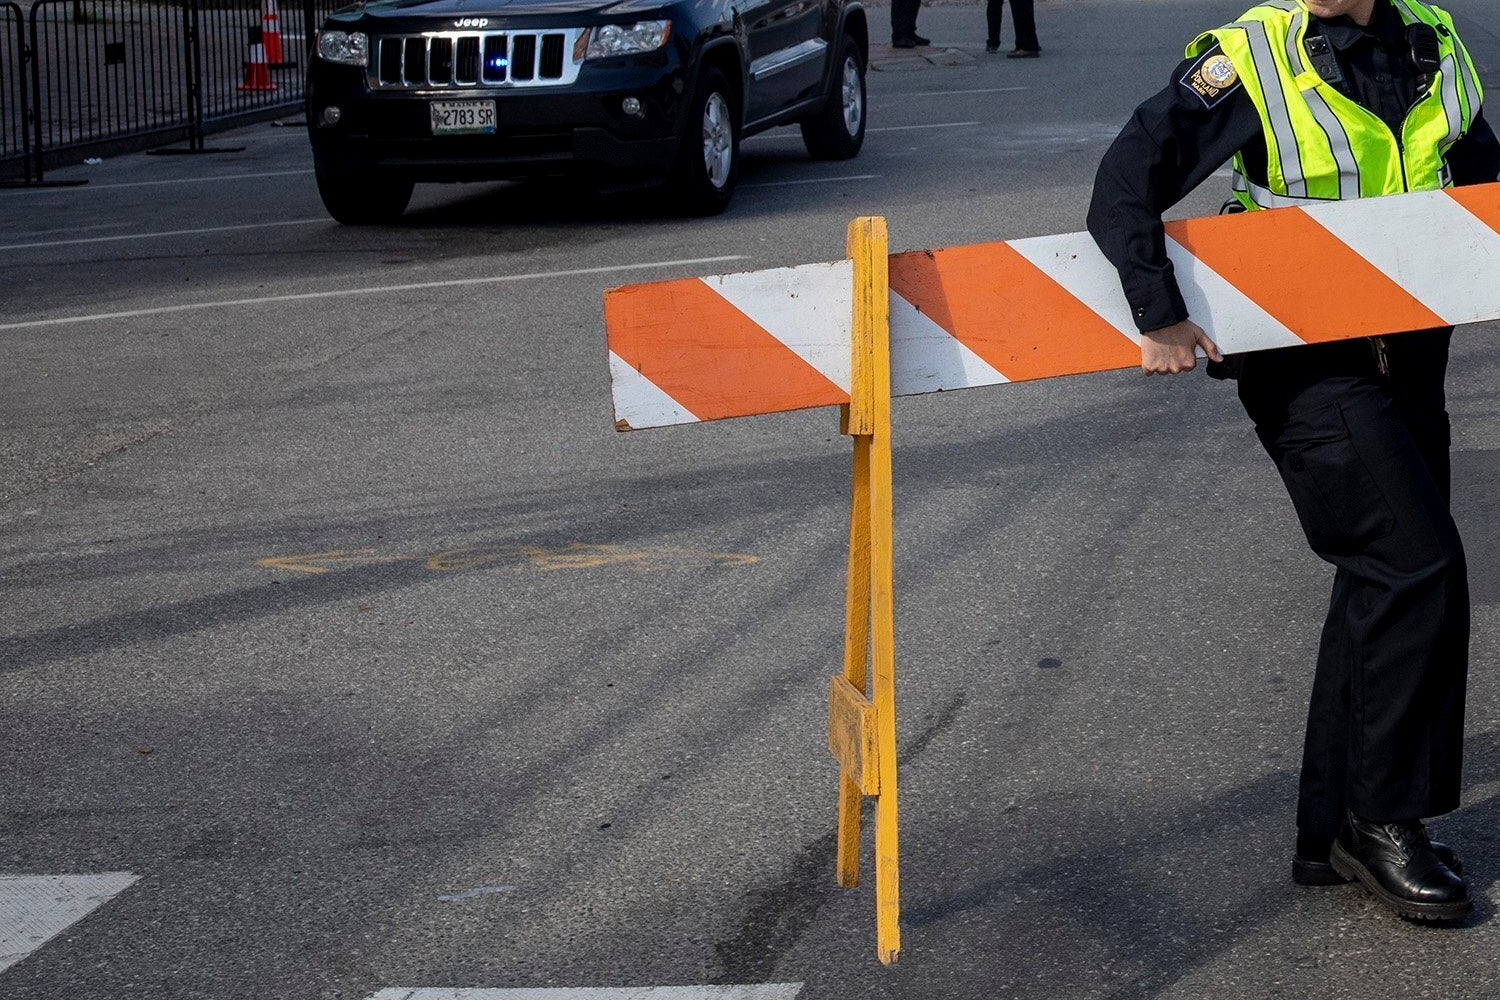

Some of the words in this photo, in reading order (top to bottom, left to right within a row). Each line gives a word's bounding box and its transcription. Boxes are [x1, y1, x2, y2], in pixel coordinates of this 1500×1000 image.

[454, 17, 489, 28] Jeep
[1191, 69, 1220, 98] PORTLAND
[1191, 82, 1207, 96] MAINE
[444, 109, 475, 126] 2783
[479, 108, 493, 125] SR
